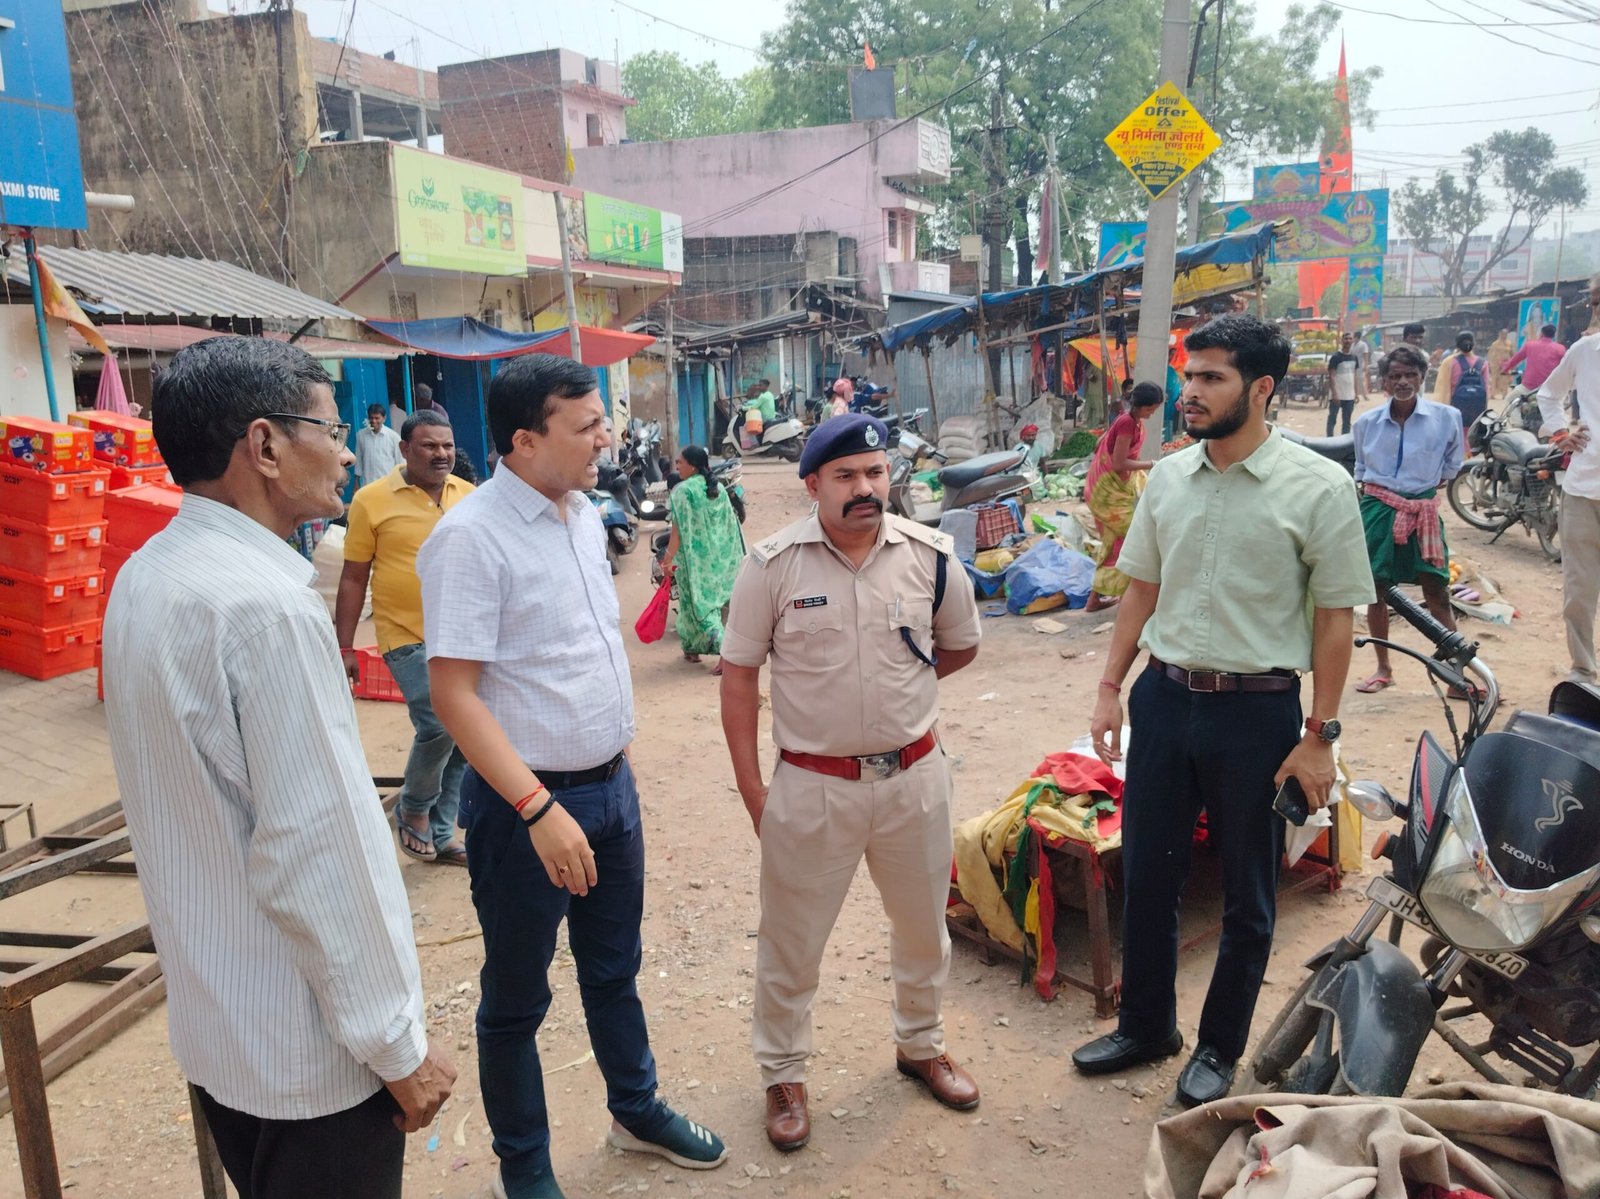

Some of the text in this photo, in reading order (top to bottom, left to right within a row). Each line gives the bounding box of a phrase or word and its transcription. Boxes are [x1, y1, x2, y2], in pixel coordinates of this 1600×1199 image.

[1155, 96, 1180, 106] Festival
[1144, 106, 1189, 116] Offer
[1116, 130, 1130, 144] न्यू
[1132, 128, 1166, 141] निर्मला
[27, 184, 60, 202] STORE
[1500, 841, 1556, 874] HONDA
